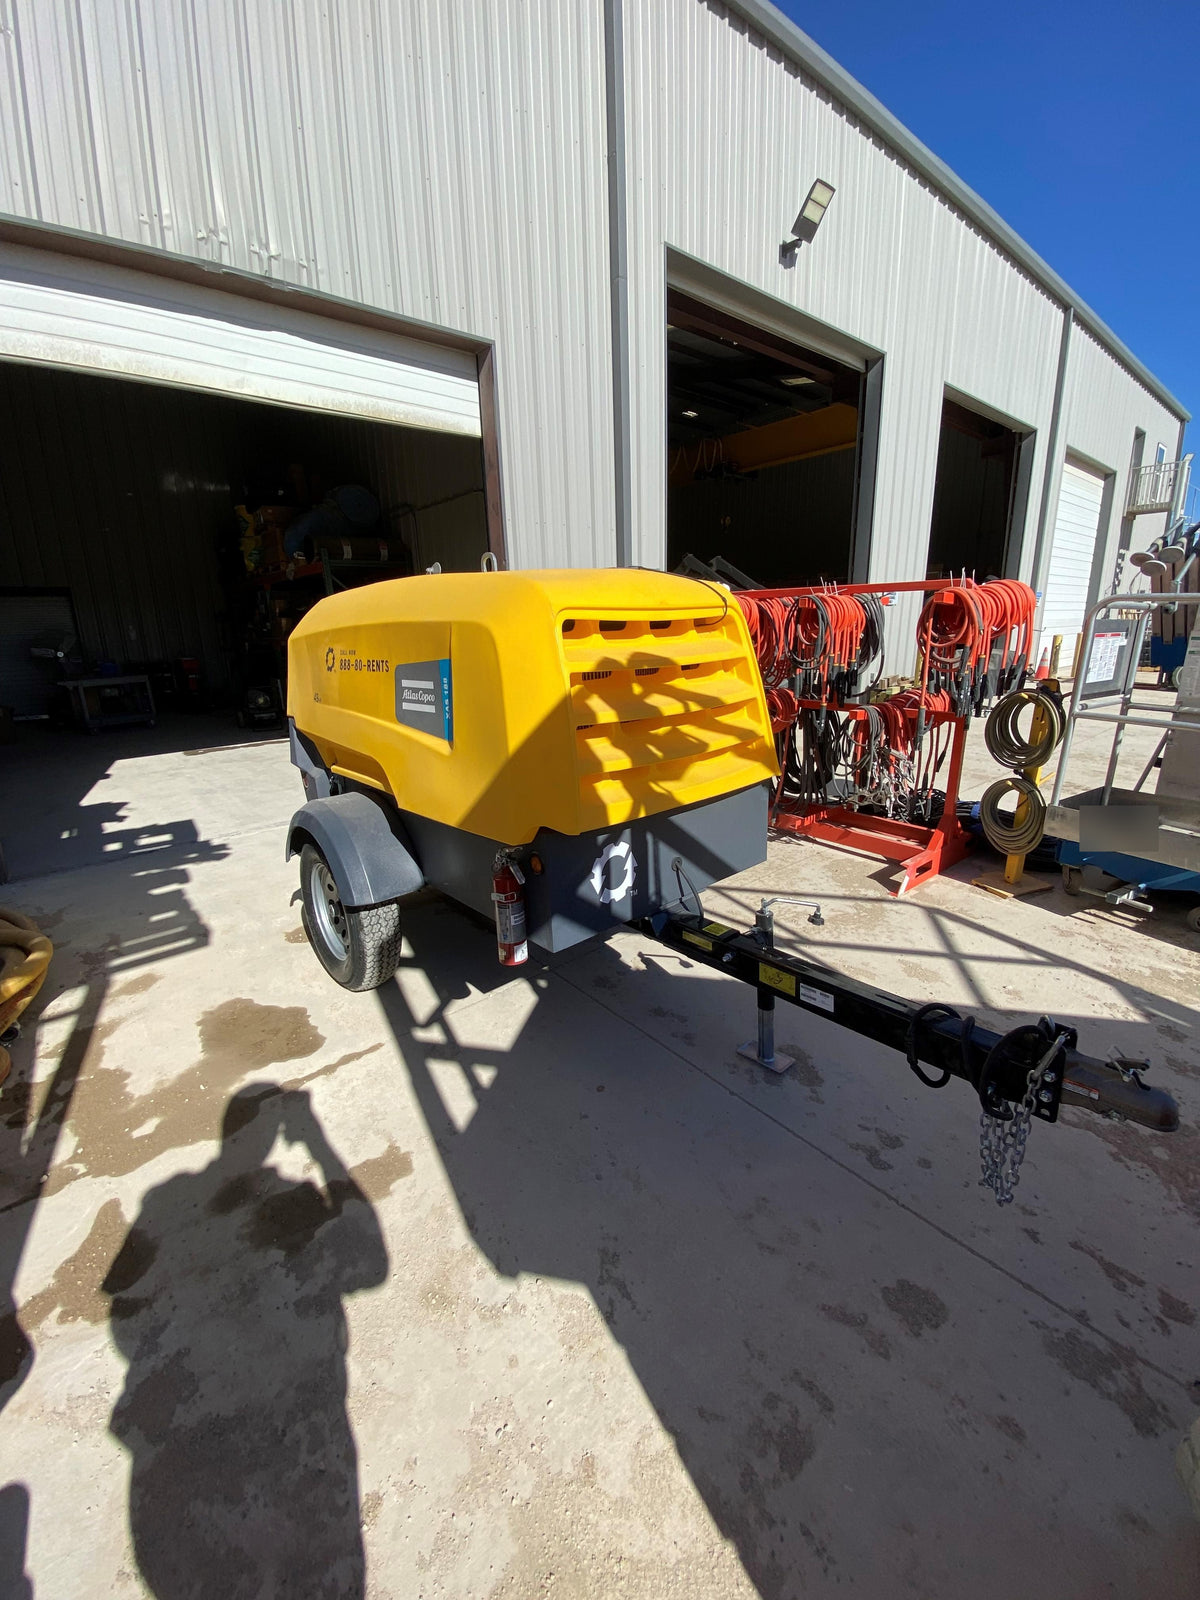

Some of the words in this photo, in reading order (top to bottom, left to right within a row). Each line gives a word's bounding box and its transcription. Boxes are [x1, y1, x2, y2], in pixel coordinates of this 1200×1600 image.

[340, 658, 390, 673] 888-80-RENTS
[402, 689, 418, 701] Atlas
[418, 690, 436, 703] Copco
